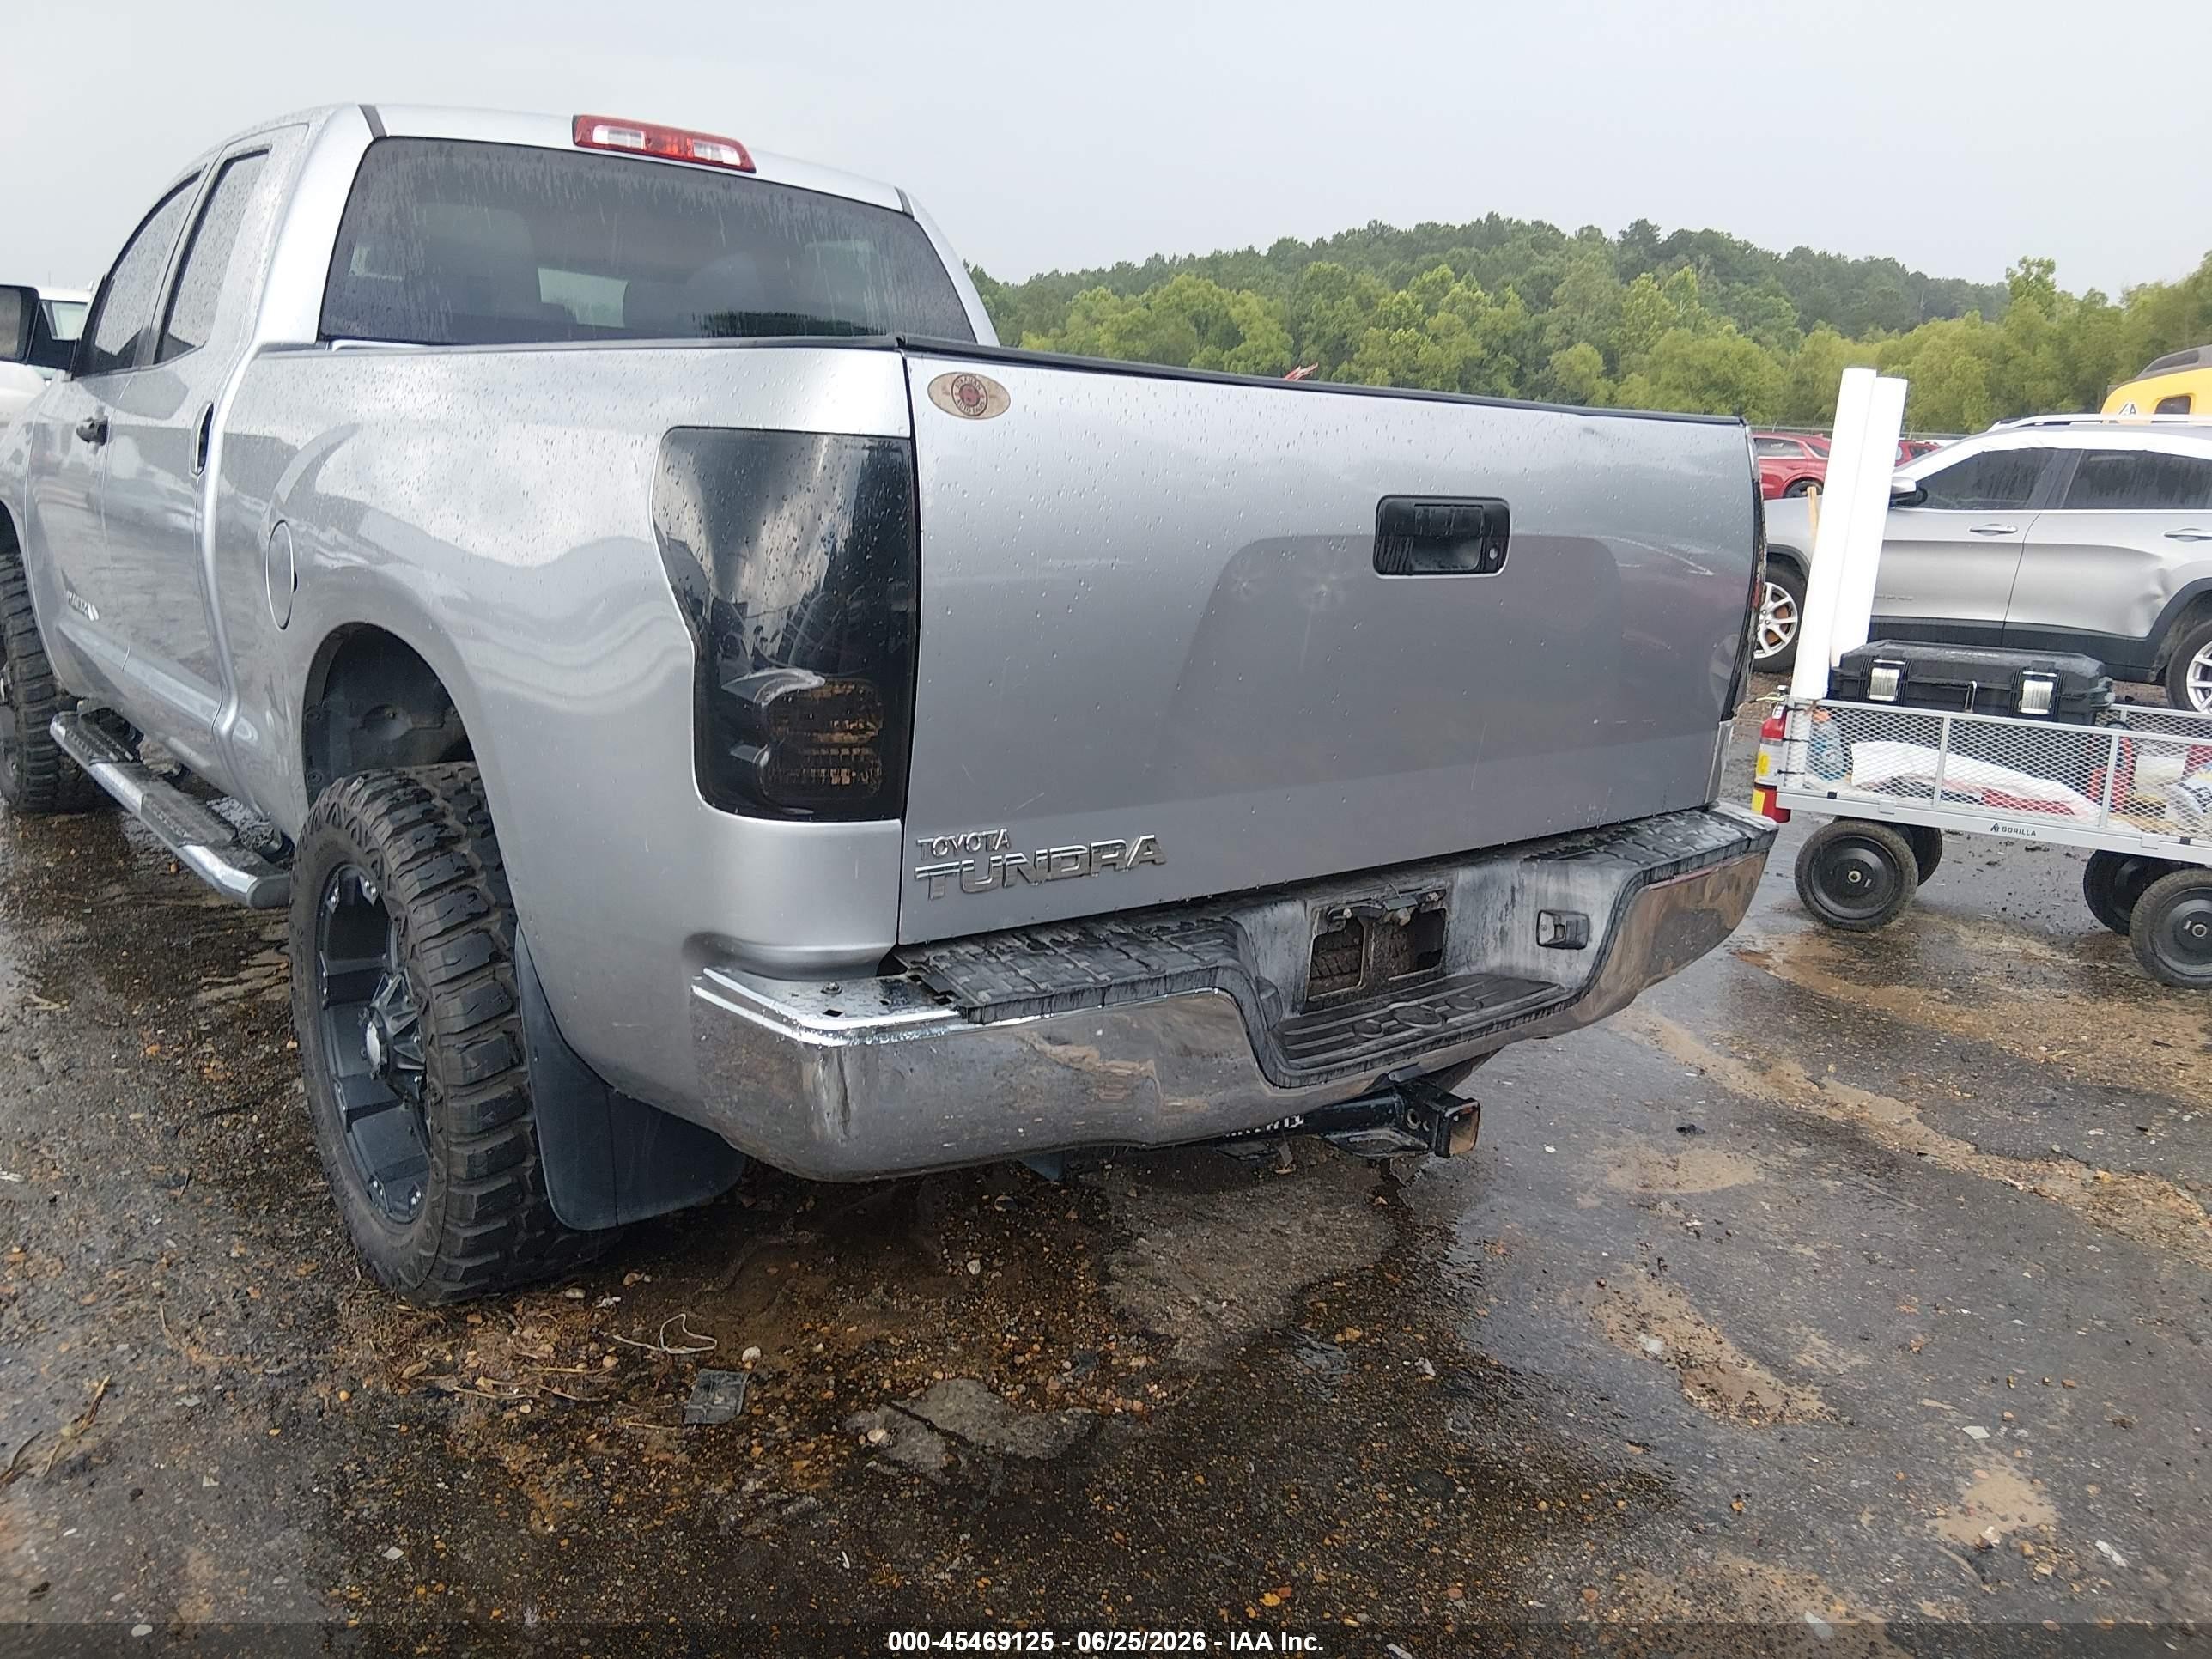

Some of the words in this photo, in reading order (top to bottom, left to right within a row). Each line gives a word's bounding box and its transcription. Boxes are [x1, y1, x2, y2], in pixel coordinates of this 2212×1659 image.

[916, 828, 1010, 860] TOYOTA
[2002, 826, 2036, 836] GORILLA
[914, 834, 1166, 901] TUNDRA
